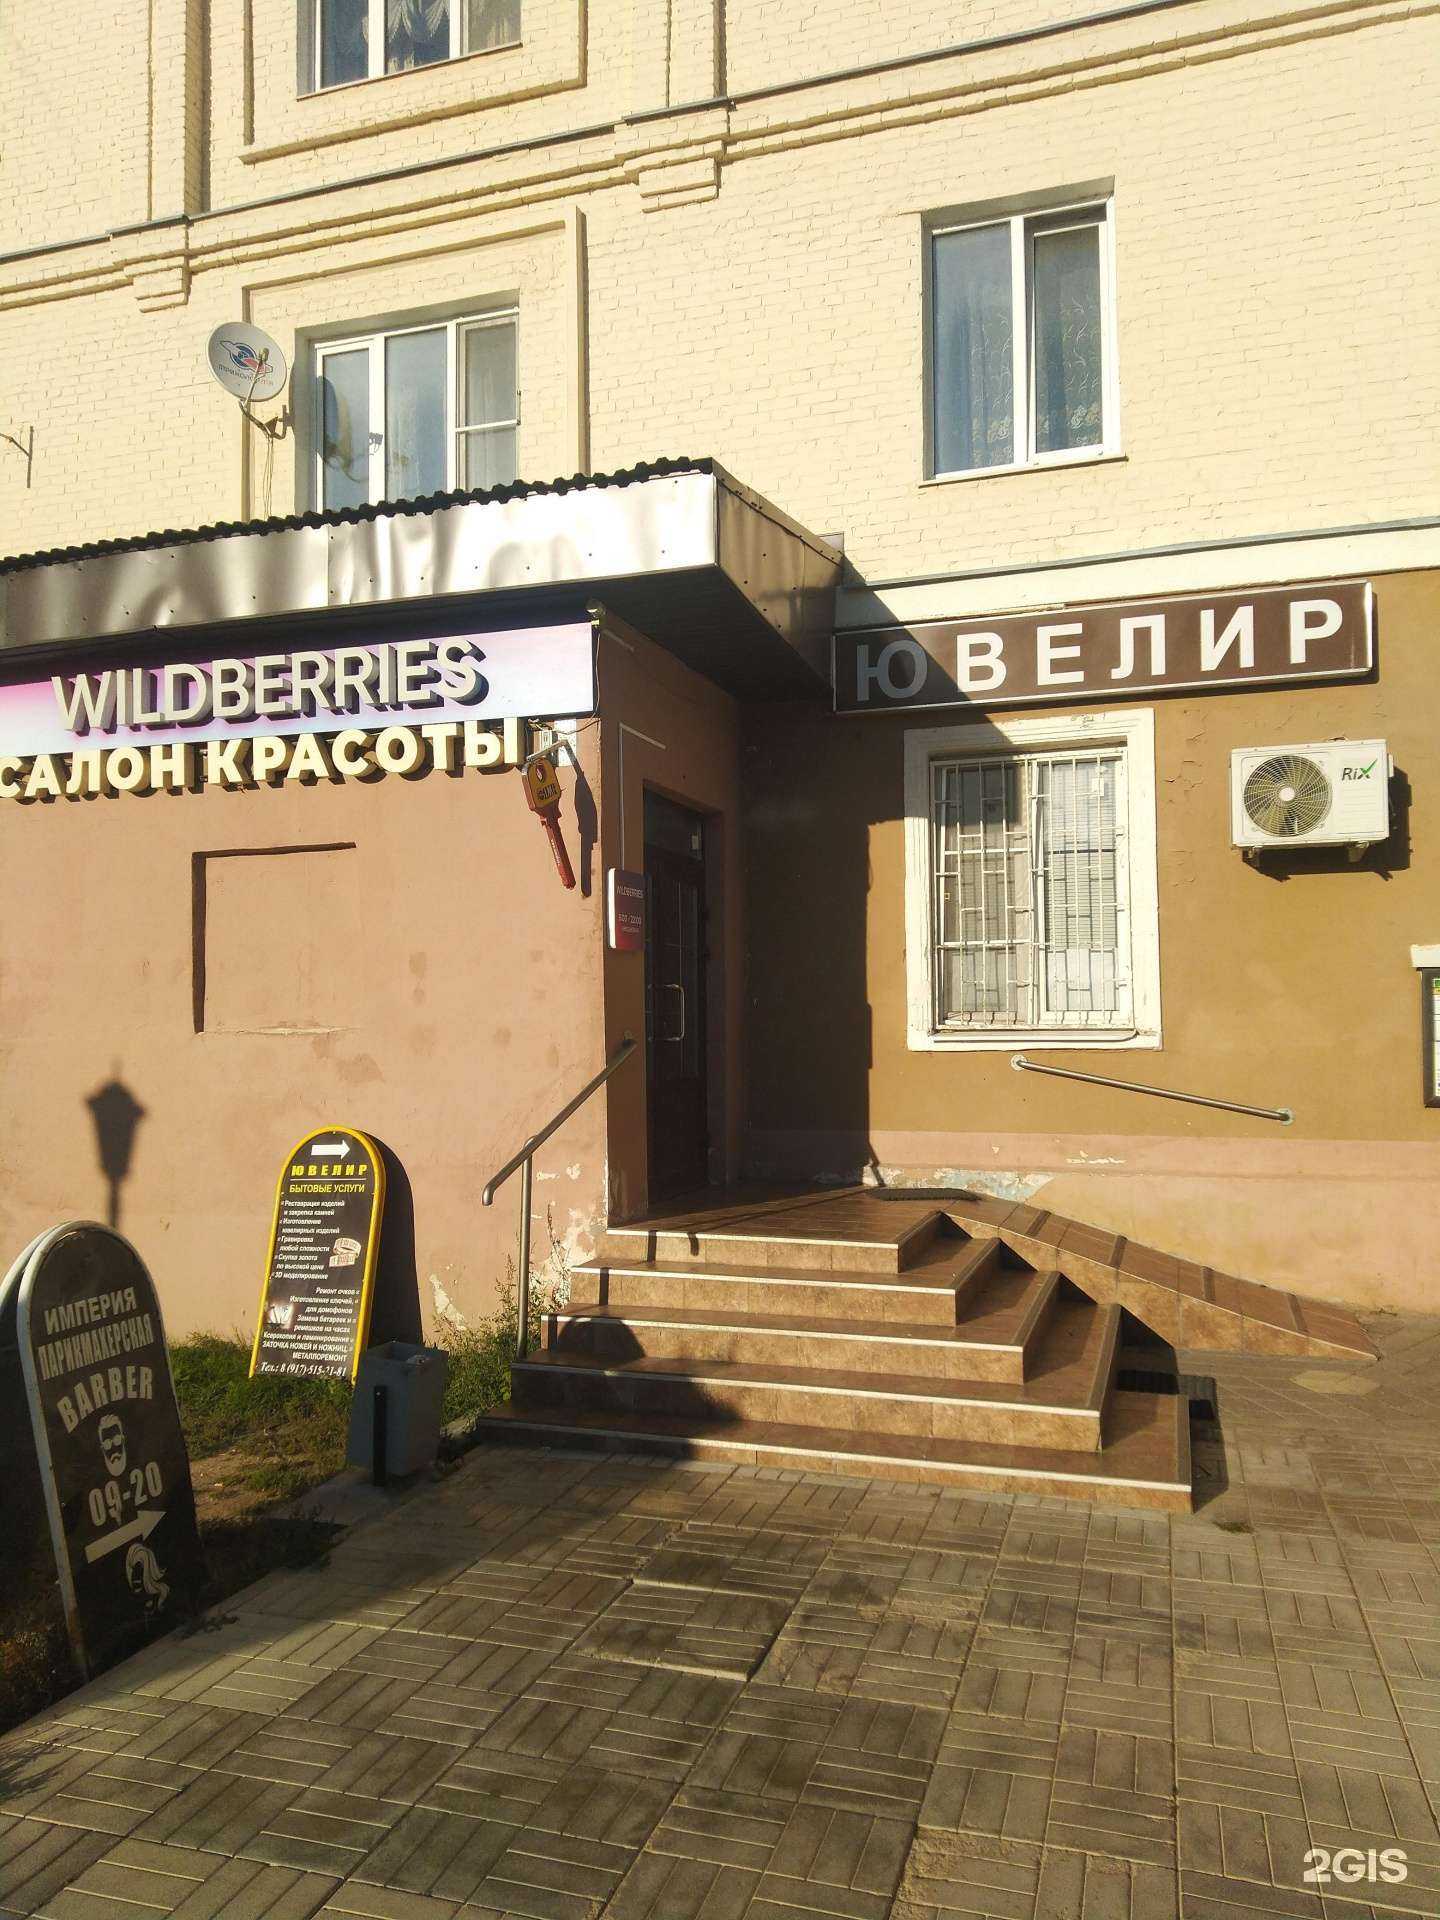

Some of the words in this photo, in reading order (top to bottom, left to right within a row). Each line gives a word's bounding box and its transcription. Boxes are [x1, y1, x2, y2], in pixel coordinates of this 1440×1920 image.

[856, 598, 1344, 702] ЮВЕЛИР
[51, 637, 482, 732] WILDBERRIES
[0, 742, 190, 798] САЛОН
[207, 718, 521, 786] КРАСОТЫ
[1341, 758, 1378, 780] Rix
[291, 1165, 368, 1176] ЮВЕЛИР
[289, 1184, 332, 1193] БЫТОВЫЕ
[333, 1184, 365, 1193] УСЛУГИ
[315, 1287, 337, 1295] Ремонт
[44, 1286, 138, 1335] ИМПЕРИЯ
[297, 1314, 319, 1322] Замена
[38, 1312, 155, 1381] ПАРИКМАХЕРСКАЯ
[262, 1341, 289, 1350] ЗАТОЧКА
[289, 1342, 311, 1351] НОЖЕЙ
[312, 1343, 318, 1351] И
[292, 1352, 348, 1362] МЕТАЛЛОРЕМОНТ
[280, 1363, 286, 1373] 8
[56, 1365, 153, 1434] BARBER
[89, 1461, 163, 1528] 09-20
